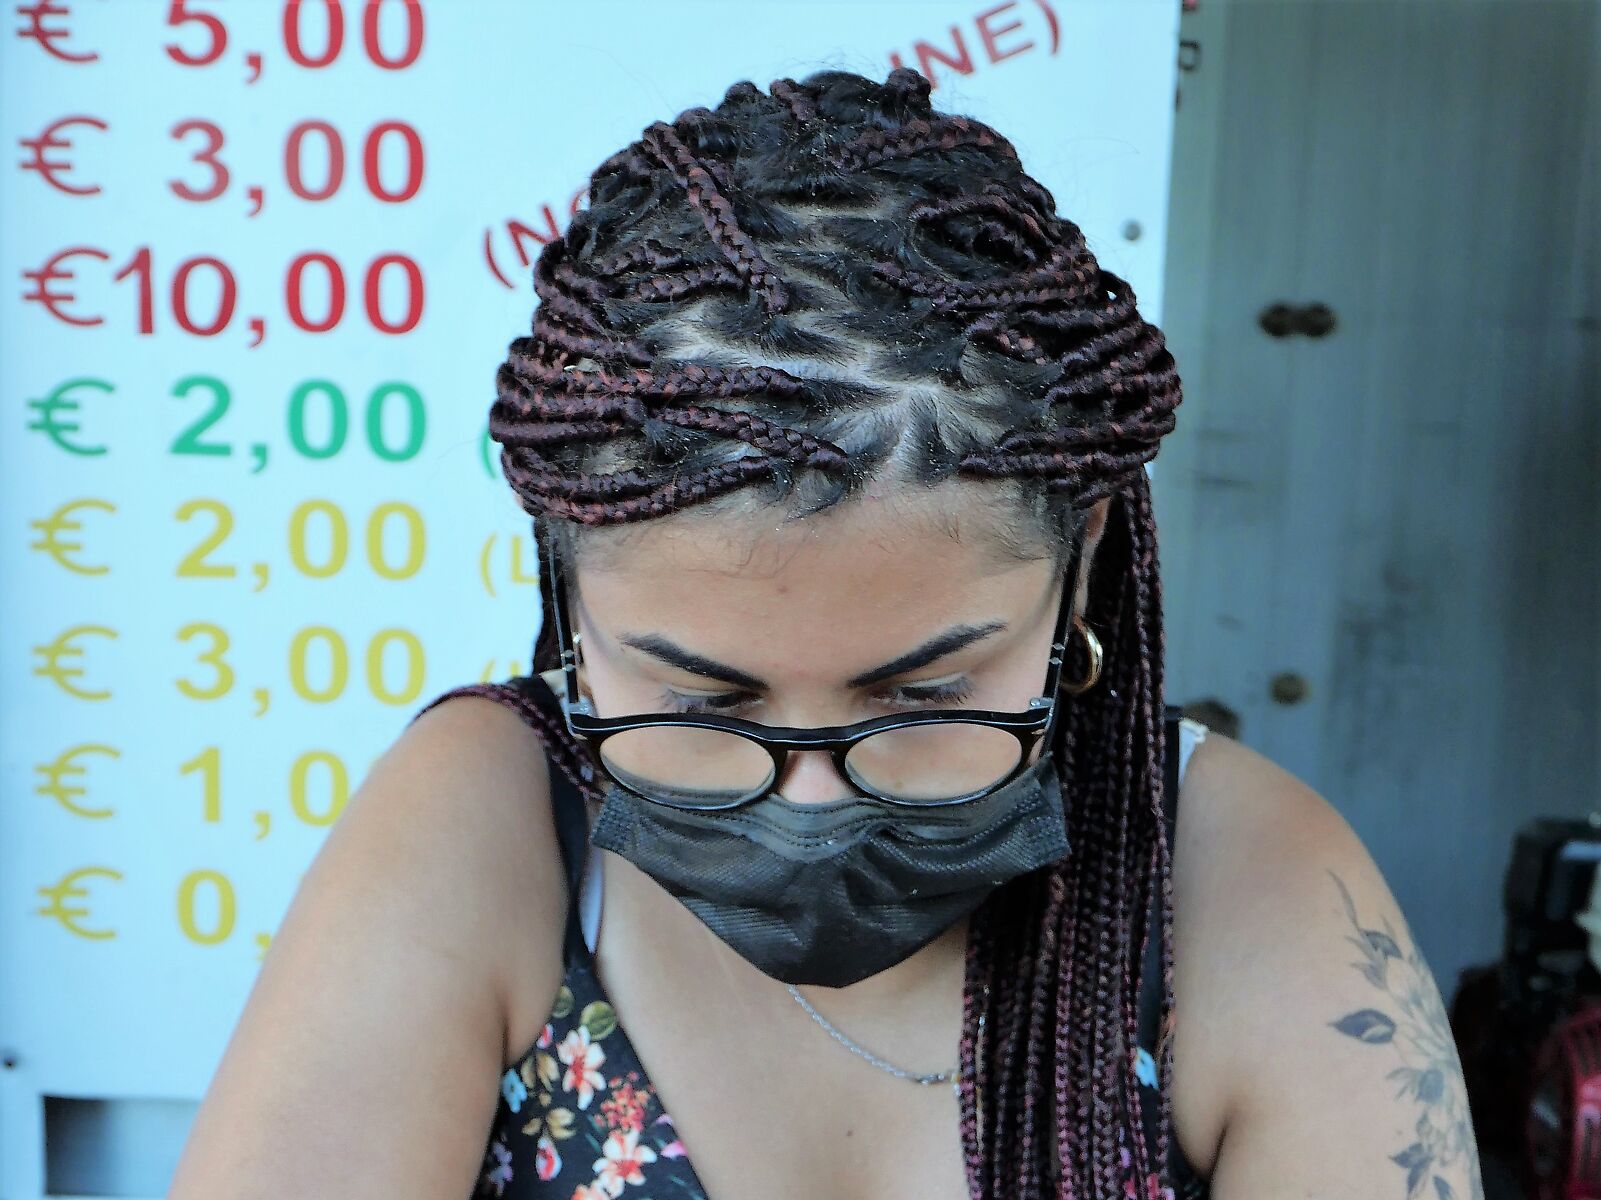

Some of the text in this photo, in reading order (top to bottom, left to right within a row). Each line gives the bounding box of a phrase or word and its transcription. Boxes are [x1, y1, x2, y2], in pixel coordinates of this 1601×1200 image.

[16, 0, 427, 84] € 5,00
[18, 115, 427, 217] € 3,00
[27, 378, 116, 457] €
[170, 376, 427, 473] 2,00
[29, 498, 118, 577] €
[173, 498, 428, 593] 2,00
[31, 621, 428, 718] € 3,00
[33, 742, 352, 841] € 1,0
[35, 865, 124, 942] €
